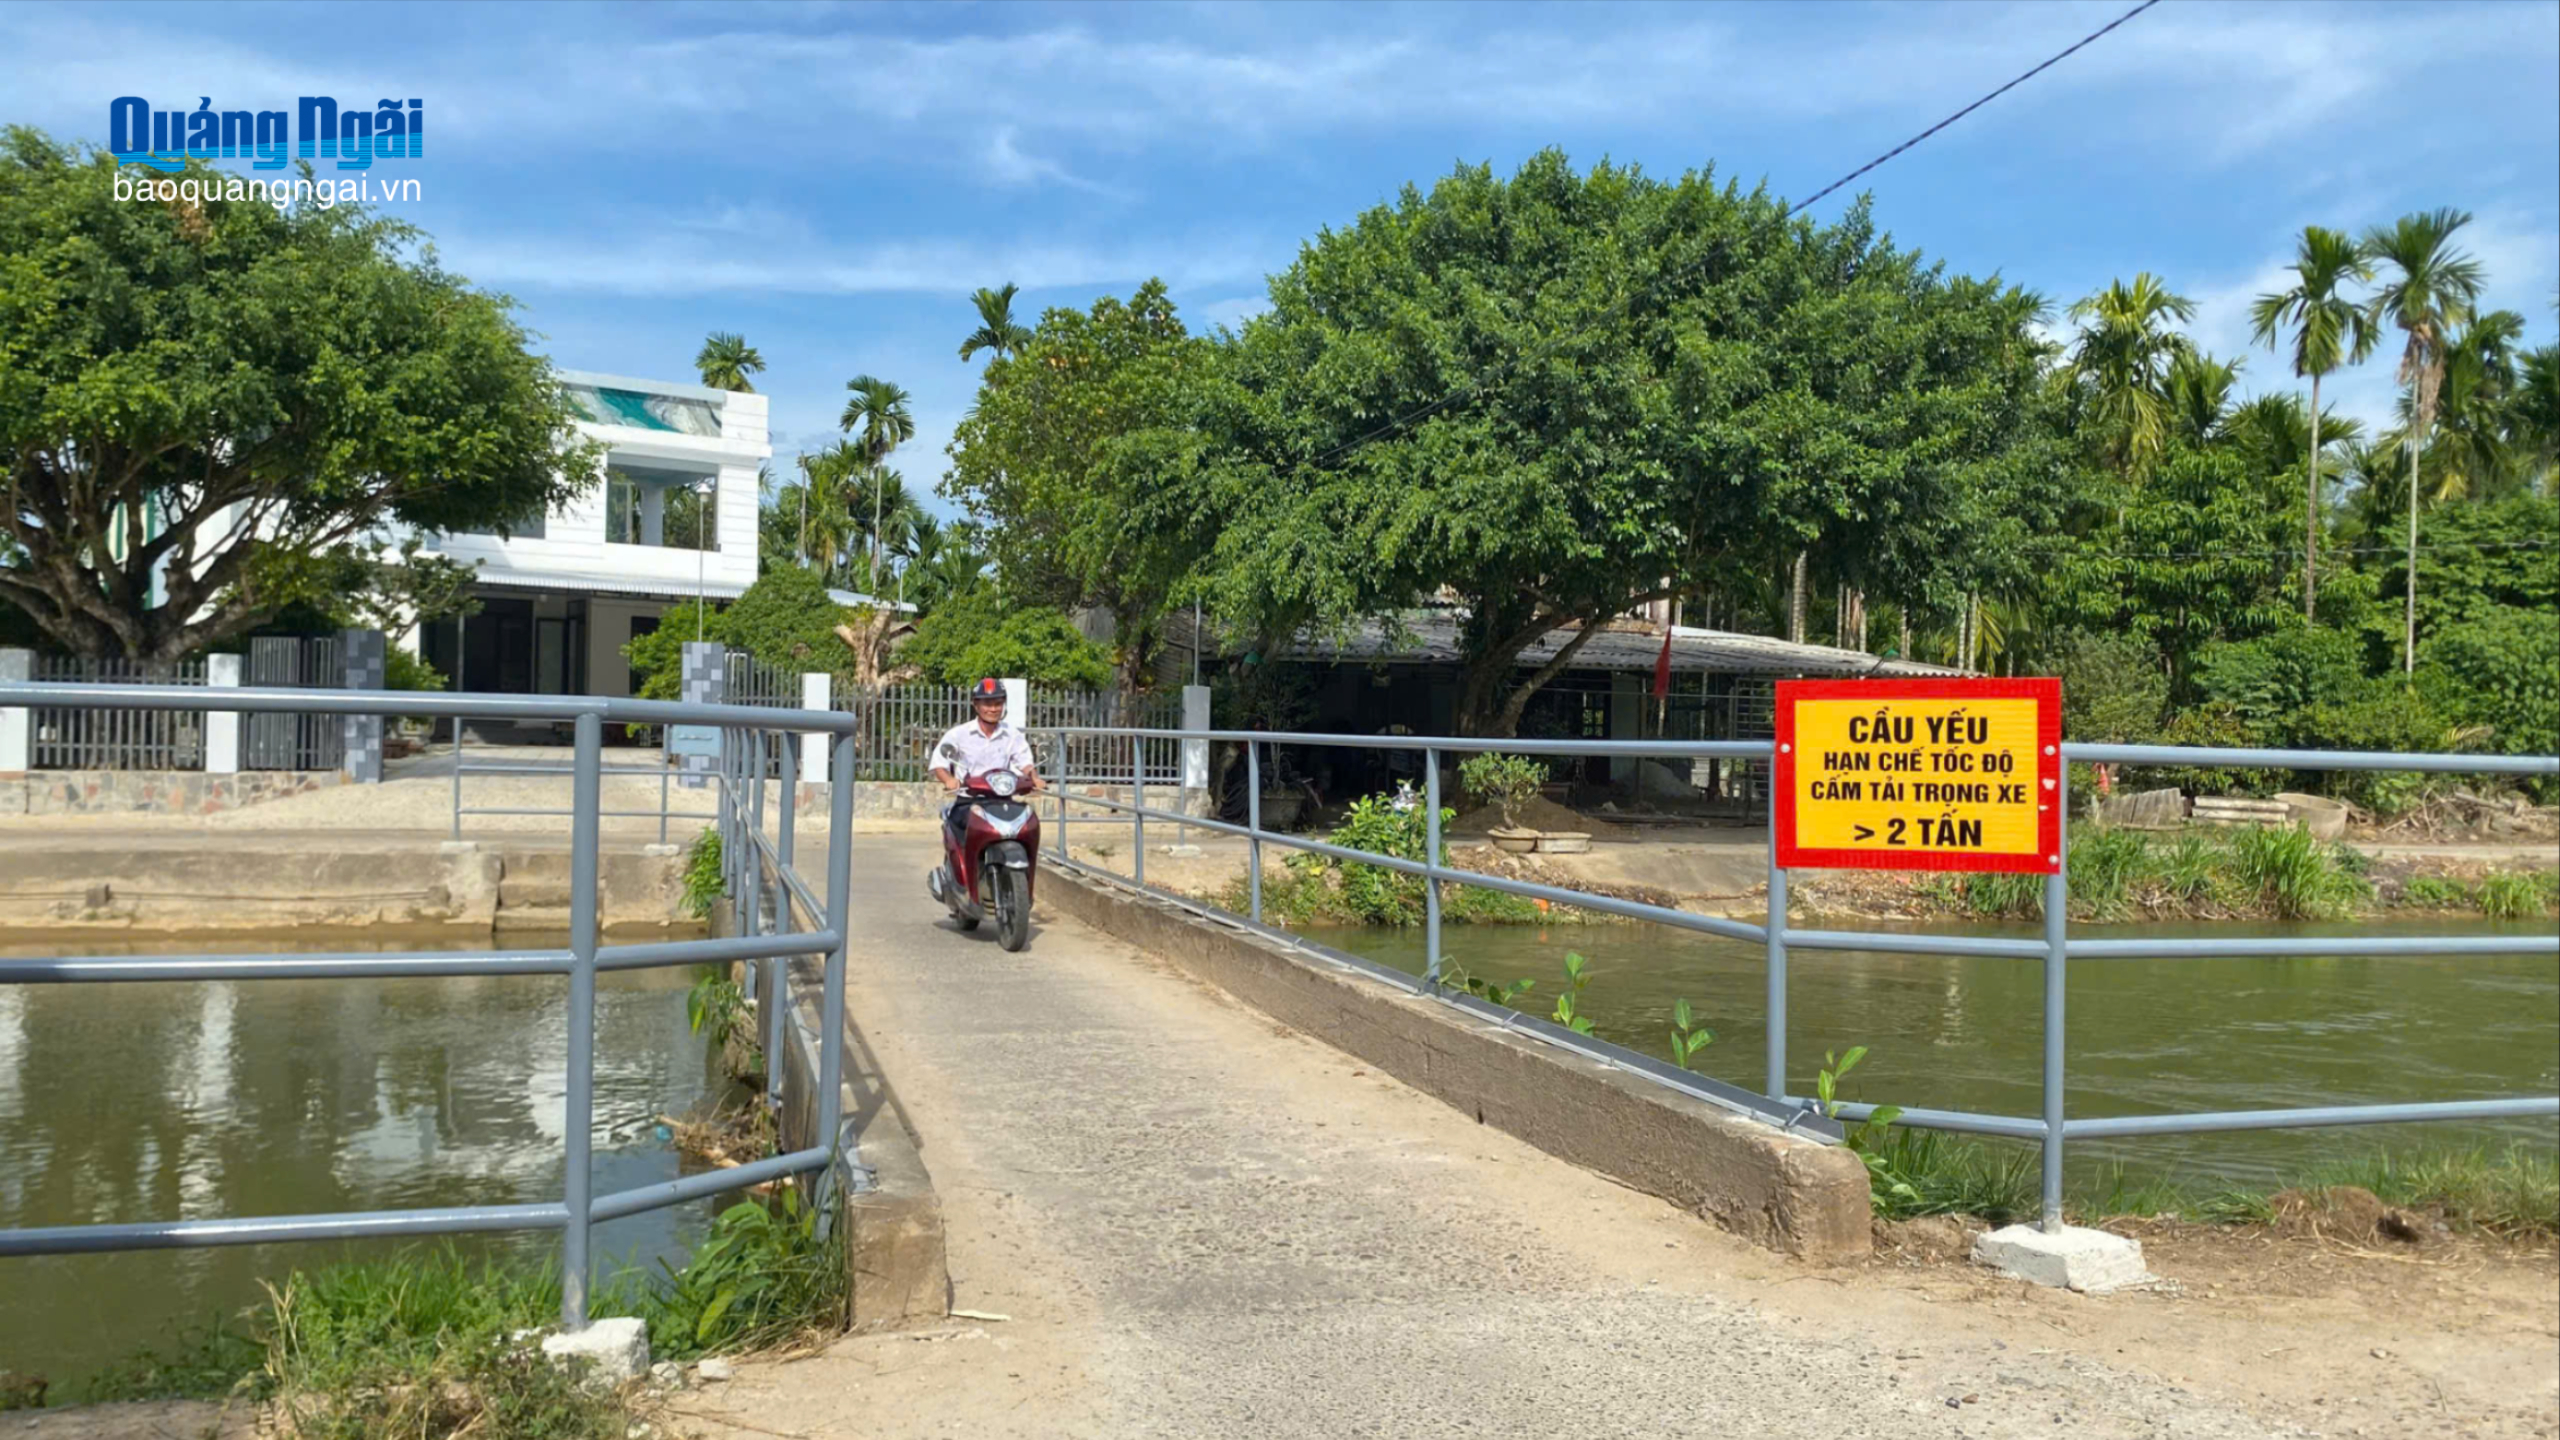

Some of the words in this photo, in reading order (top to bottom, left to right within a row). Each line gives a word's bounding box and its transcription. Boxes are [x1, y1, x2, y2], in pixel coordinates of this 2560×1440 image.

[1849, 706, 1913, 744] CẦU
[1926, 707, 1988, 744] YẾU
[1824, 752, 1870, 776] HẠN
[1878, 746, 1924, 771] CHẾ
[1931, 745, 1974, 772] TỐC
[1982, 749, 2014, 778] ĐỘ
[1811, 774, 1861, 801] CẤM
[1870, 777, 1904, 802] TẢI
[1914, 782, 1989, 808] TRỌNG
[1997, 784, 2027, 804] XE
[1854, 824, 1875, 842] >
[1887, 818, 1906, 846] 2
[1917, 809, 1982, 847] TẤN
